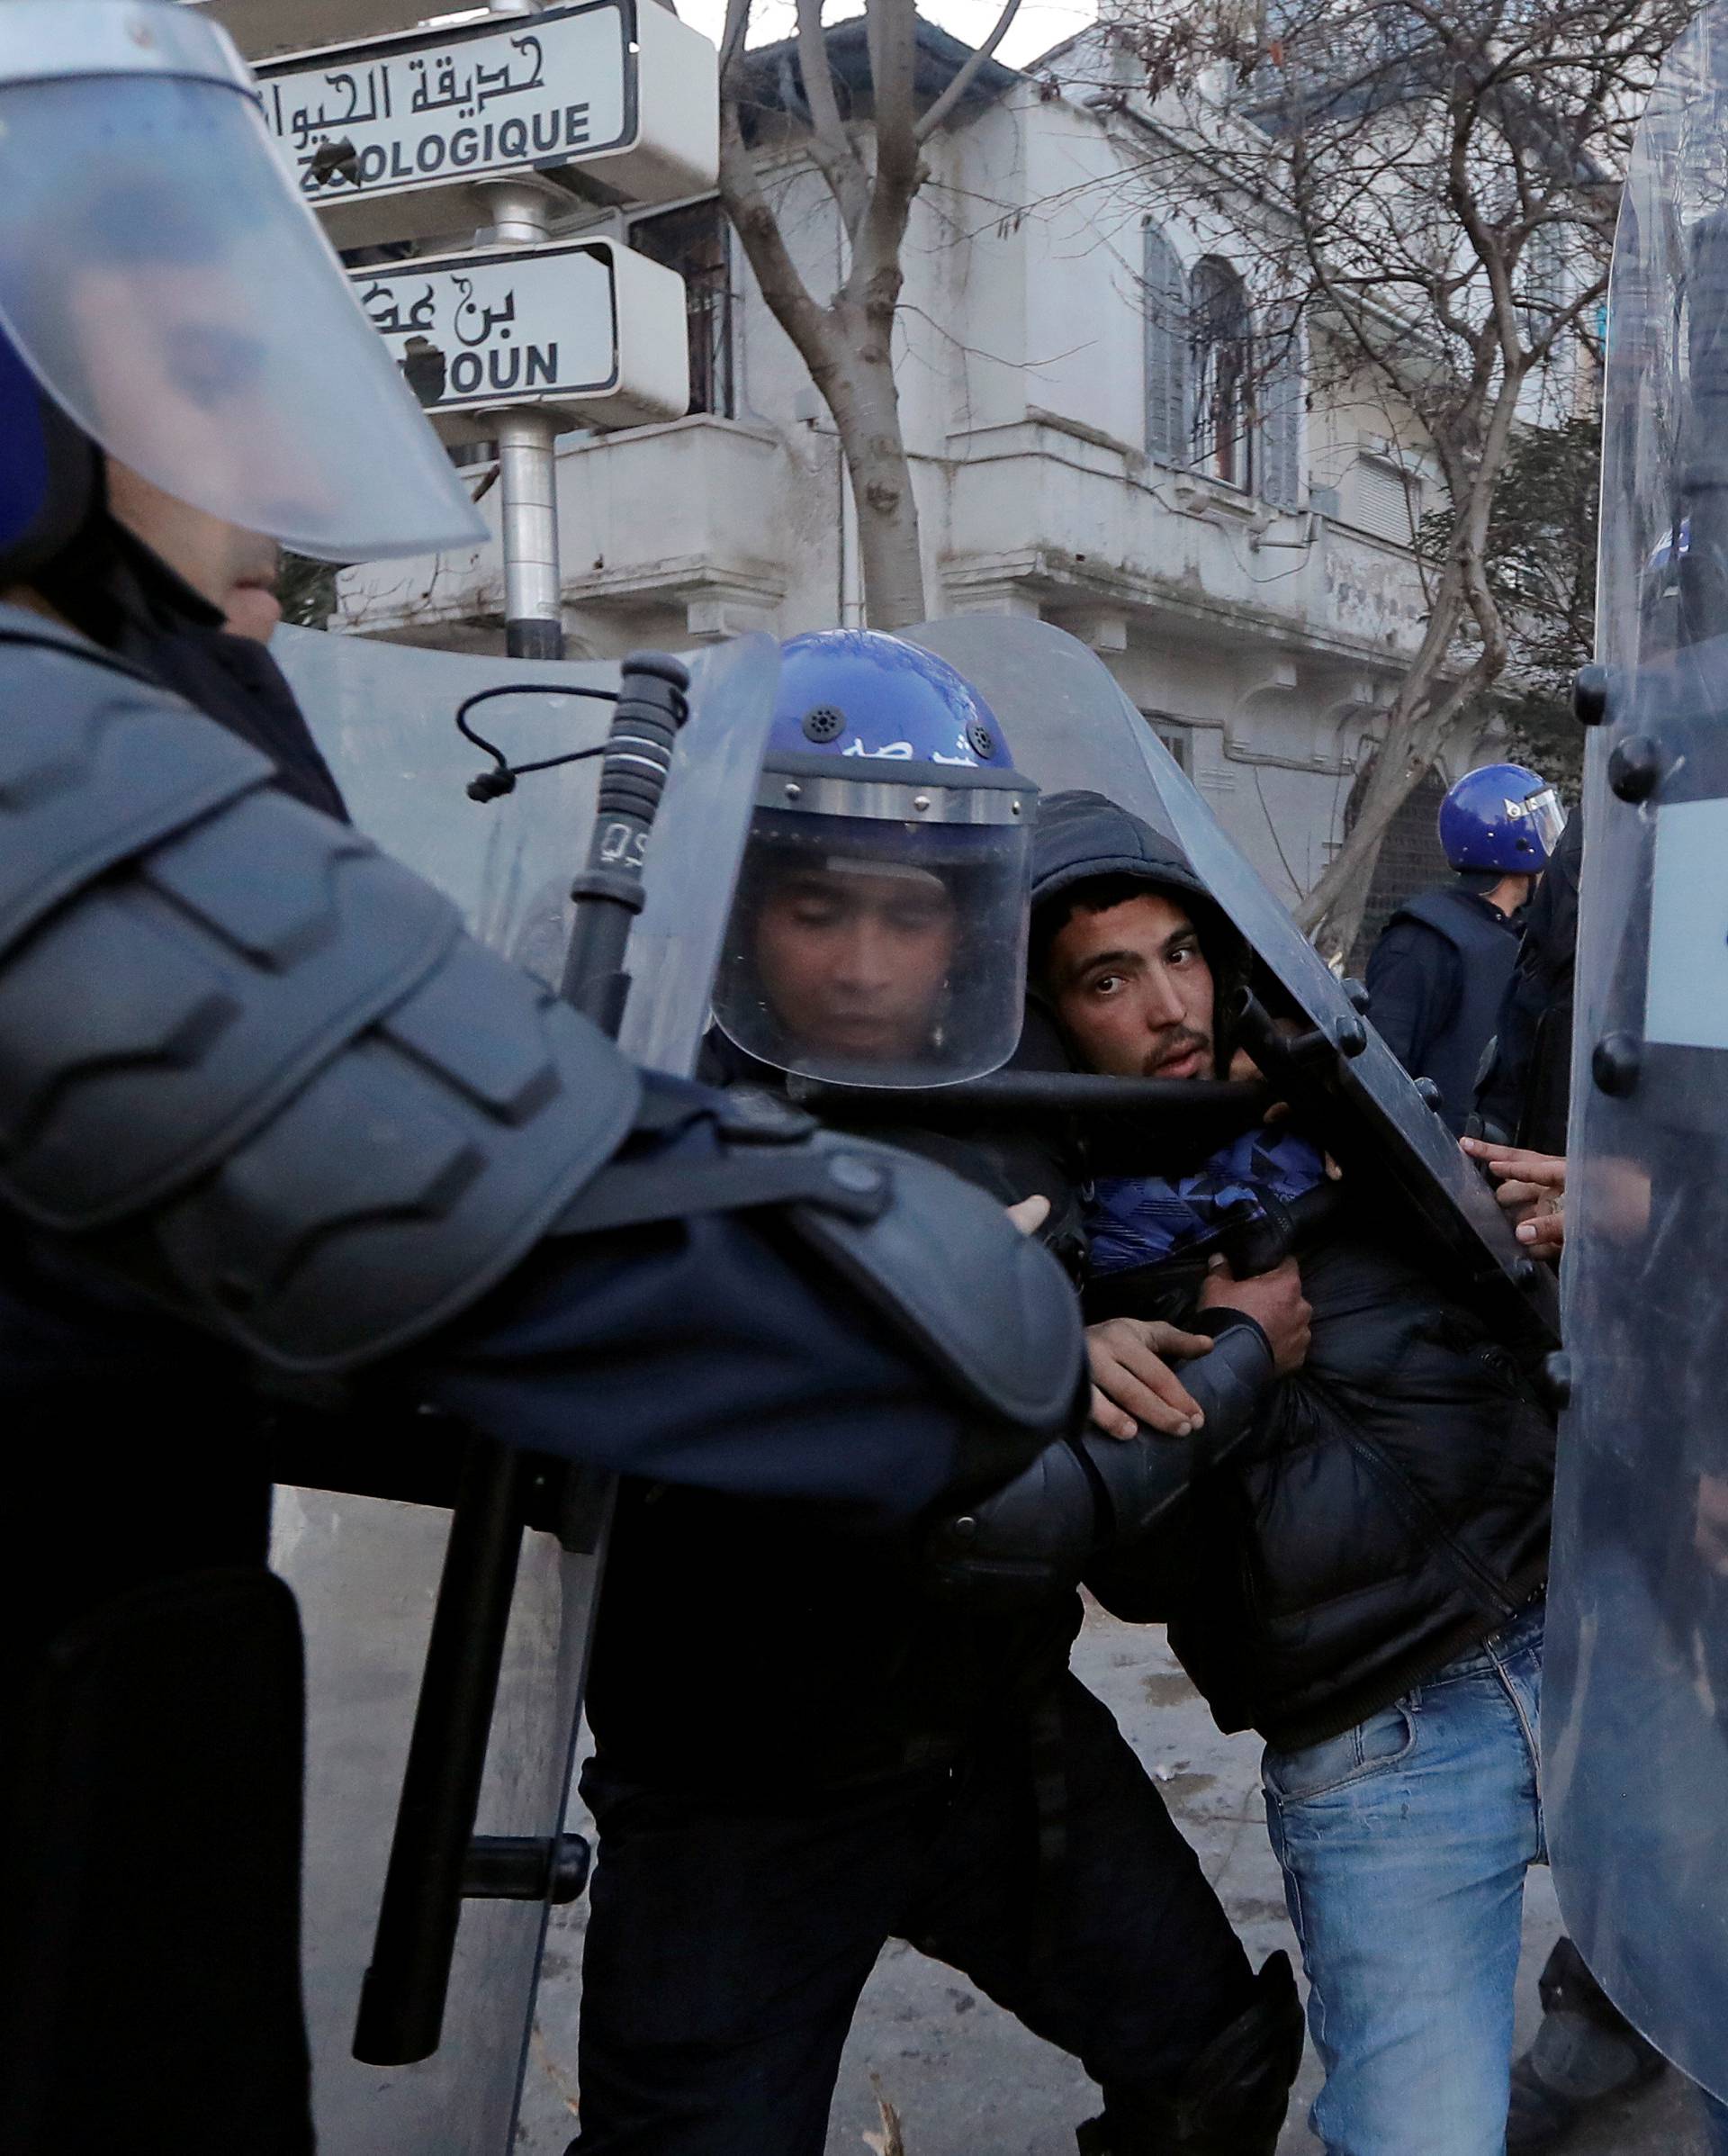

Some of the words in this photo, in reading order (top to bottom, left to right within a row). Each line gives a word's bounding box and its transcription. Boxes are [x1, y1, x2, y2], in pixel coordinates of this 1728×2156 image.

[256, 64, 392, 149] الحيوا
[411, 35, 544, 118] حديقة
[298, 103, 590, 193] ZOLOGIQUE
[451, 274, 515, 347] بن
[439, 343, 558, 393] OUN
